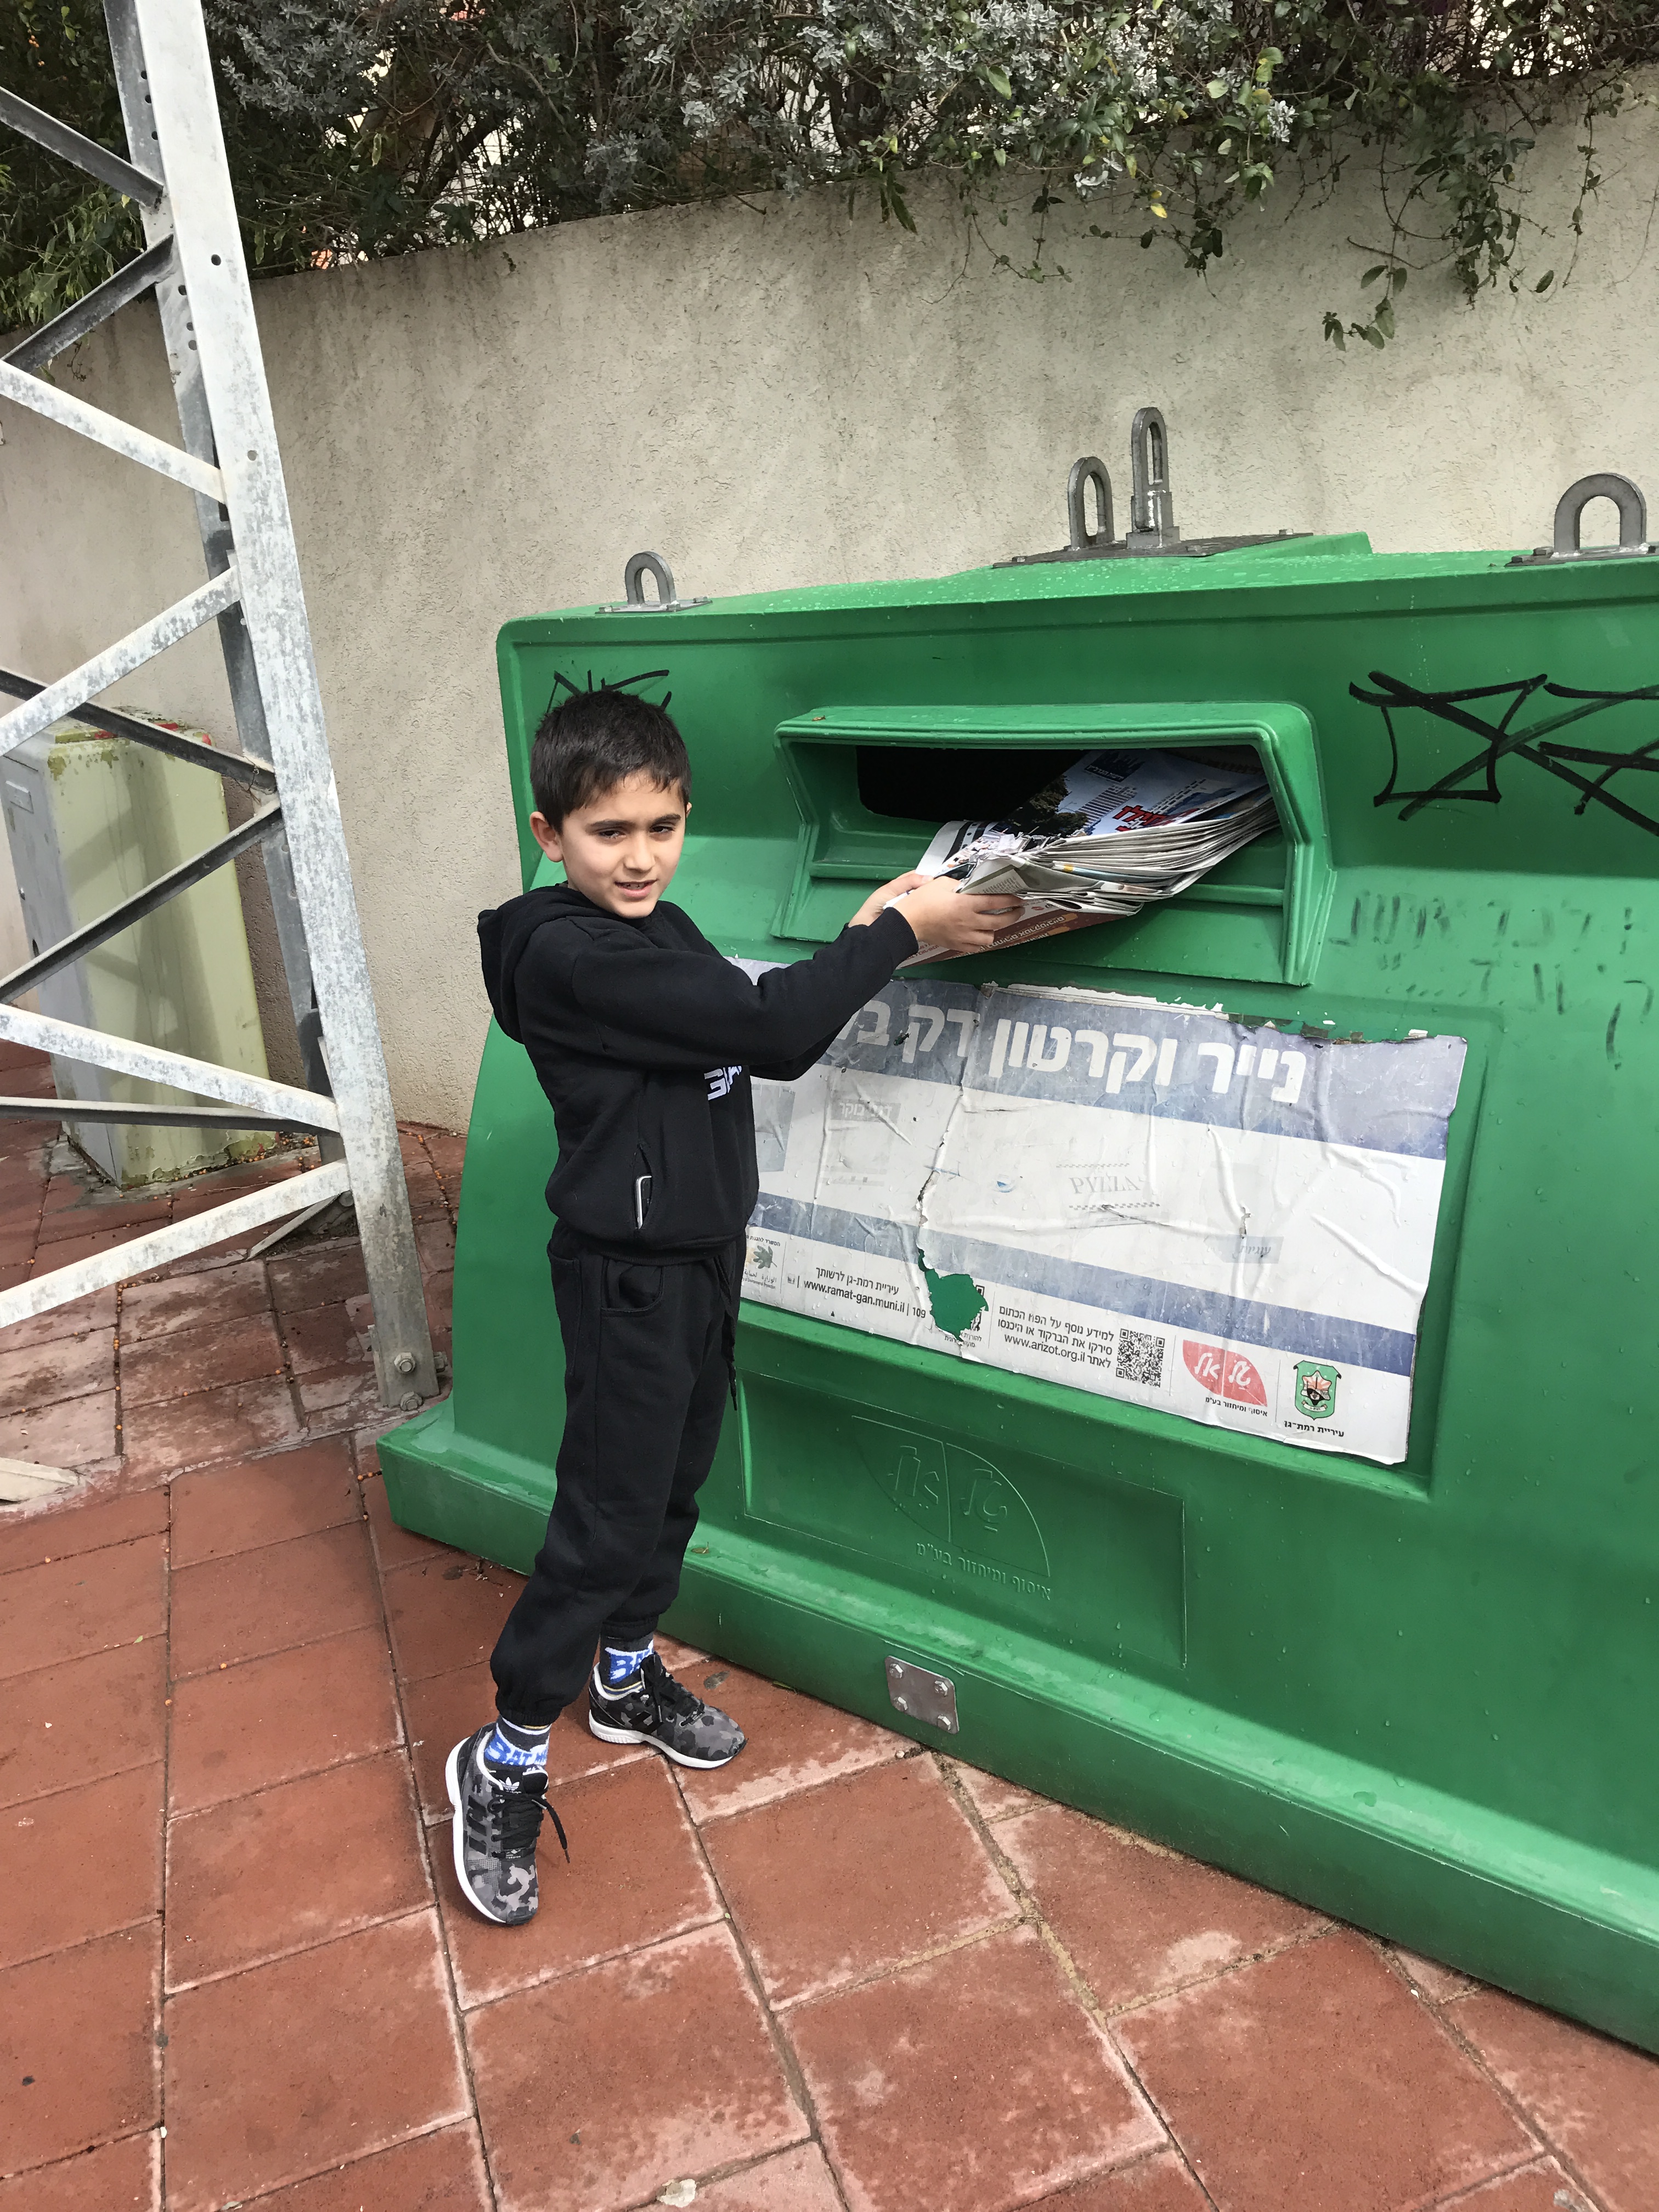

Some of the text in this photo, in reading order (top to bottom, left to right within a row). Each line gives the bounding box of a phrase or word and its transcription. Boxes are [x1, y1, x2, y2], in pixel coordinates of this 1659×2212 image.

[1019, 916, 1065, 937] אטרקטיביים
[836, 1000, 1307, 1105] נייר וקרטון רק ב
[816, 1267, 899, 1295] עיריית רמת-גן לרשותך
[804, 1279, 926, 1318] 109 www.ramat-gan.muni.il
[998, 1318, 1113, 1355] סירקו את הברקוד או היכנסו
[999, 1306, 1114, 1342] למידע נוסף על הפח הכתום
[1004, 1334, 1111, 1368] לאתר www.arizot.org.il
[1223, 1401, 1246, 1412] ומיחזור
[1248, 1407, 1268, 1417] איסוף
[1317, 1426, 1344, 1437] עיריית
[958, 1556, 1006, 1584] ומיחזור
[1012, 1576, 1051, 1601] איסוף
